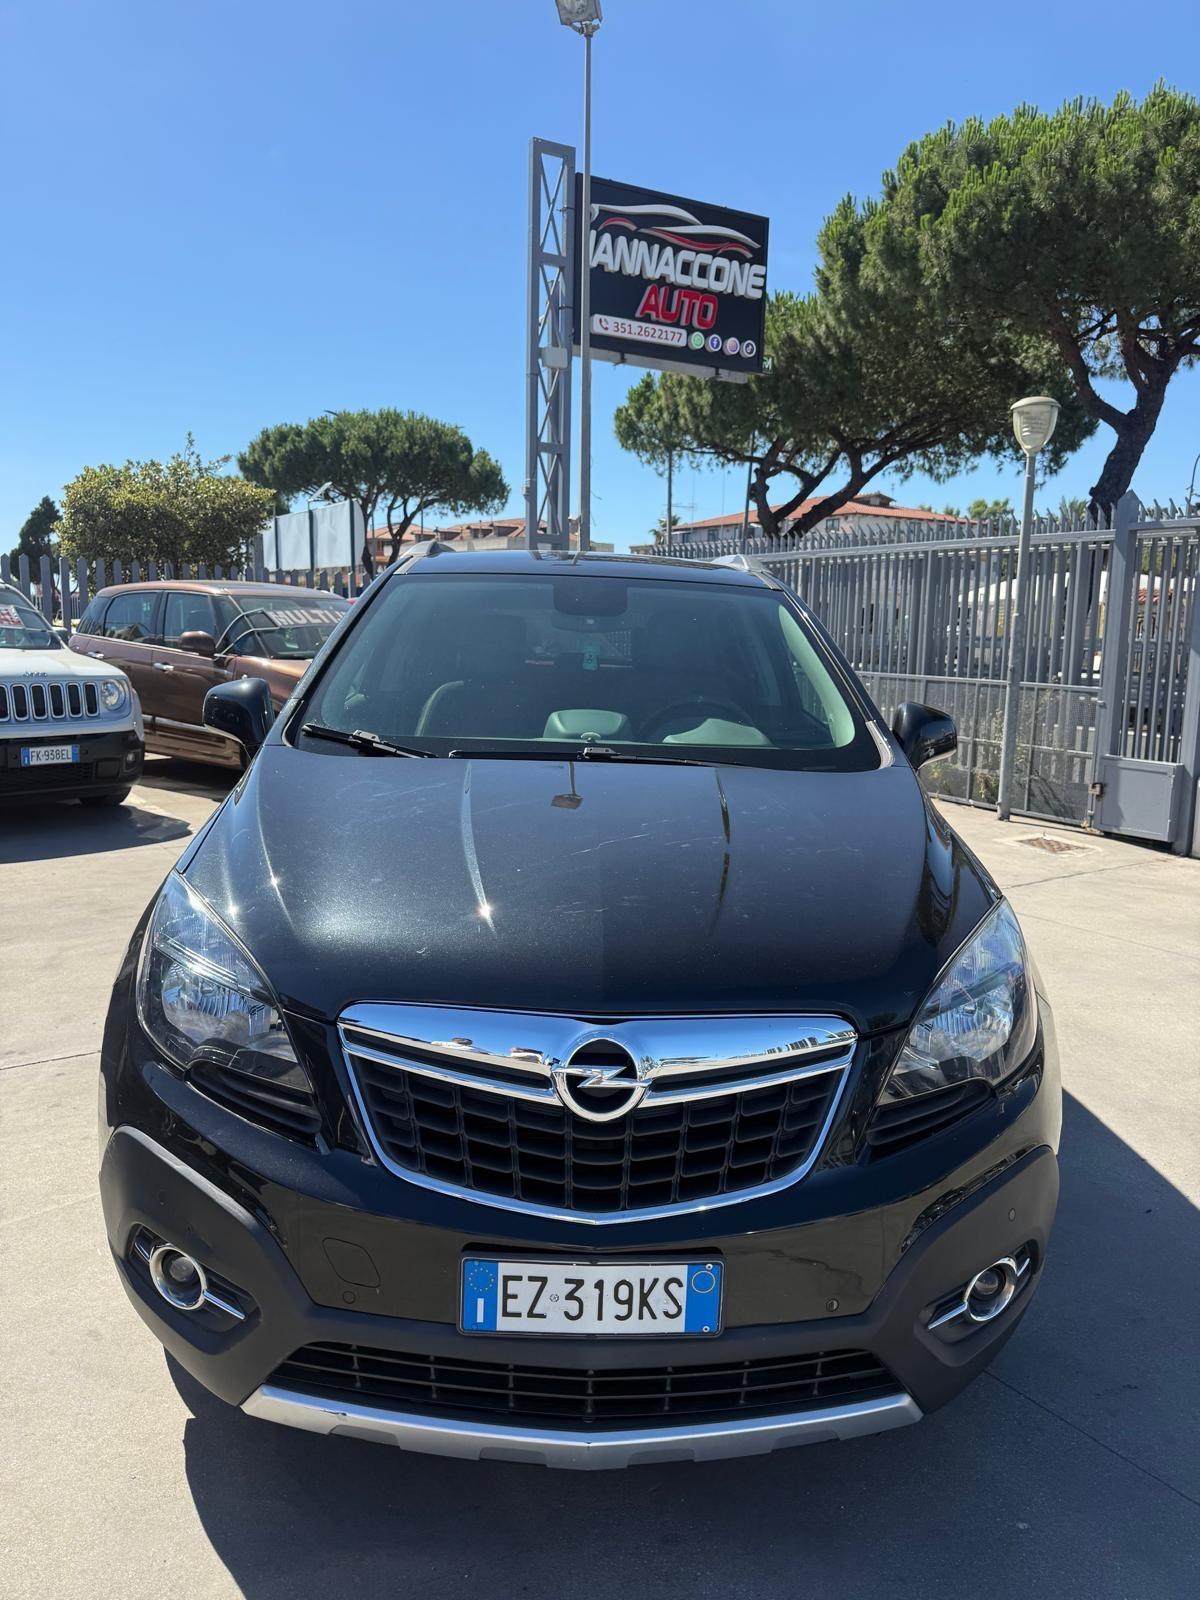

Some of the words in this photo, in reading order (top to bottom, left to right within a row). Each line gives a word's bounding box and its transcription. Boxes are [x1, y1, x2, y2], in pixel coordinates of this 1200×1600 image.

[636, 284, 718, 330] AUTO
[613, 321, 683, 342] 351.2622177
[265, 609, 346, 626] MULTIJ
[501, 1275, 548, 1319] EZ
[563, 1277, 684, 1321] 319KS
